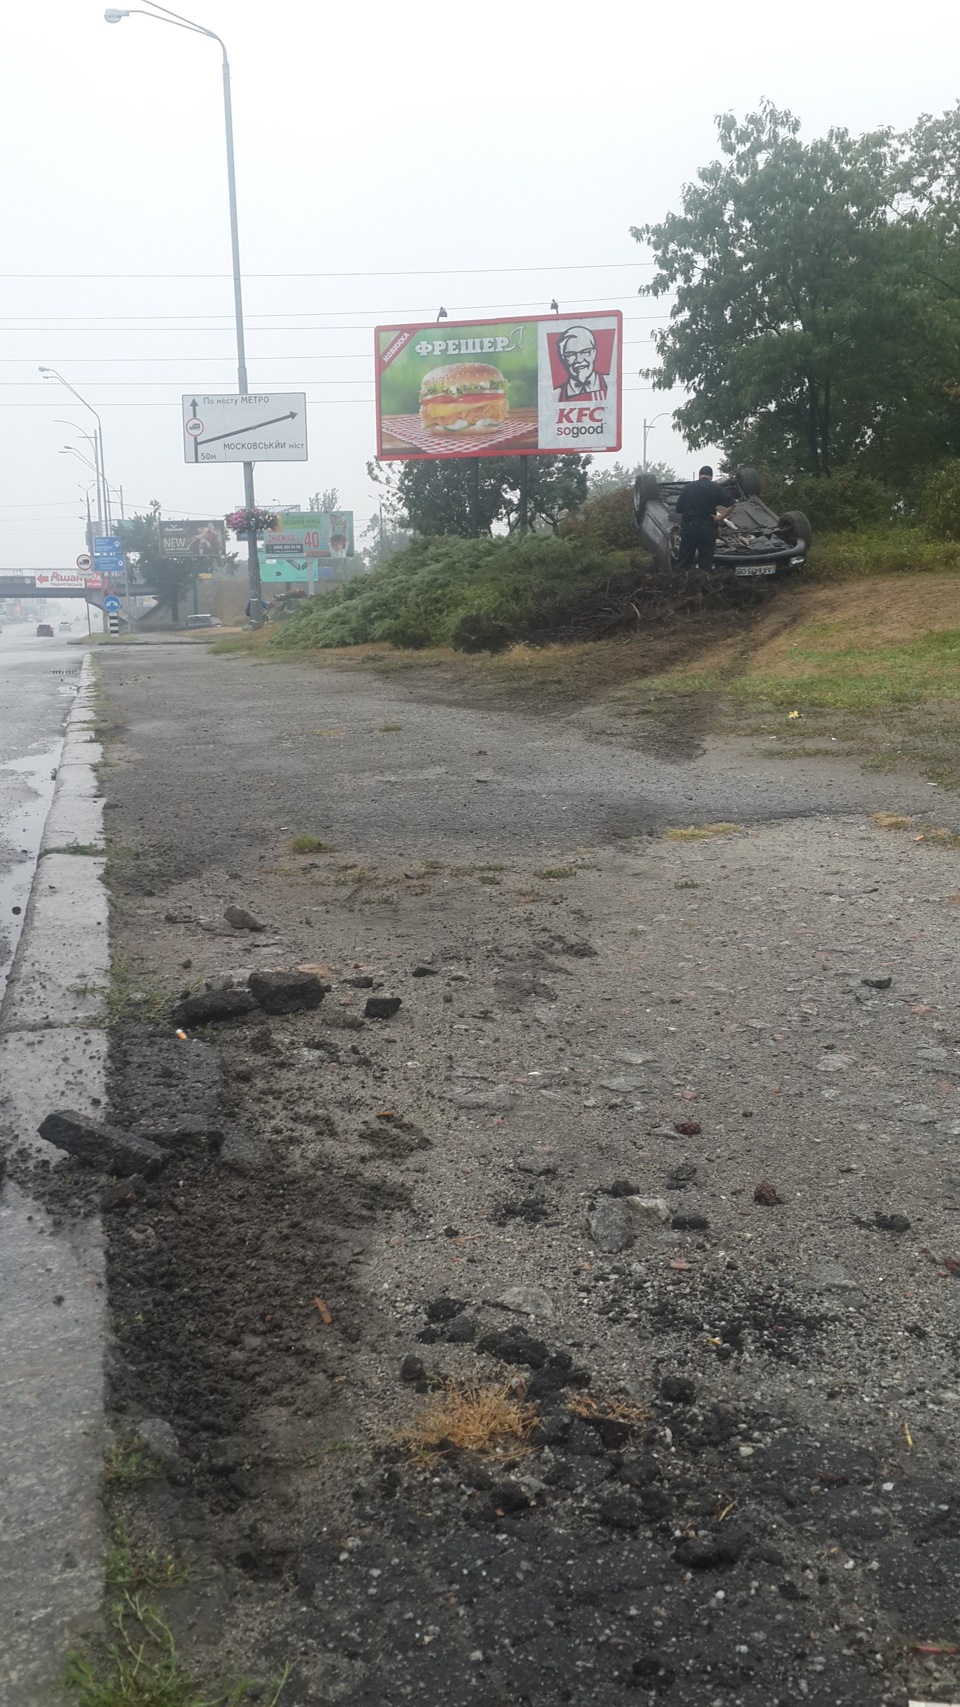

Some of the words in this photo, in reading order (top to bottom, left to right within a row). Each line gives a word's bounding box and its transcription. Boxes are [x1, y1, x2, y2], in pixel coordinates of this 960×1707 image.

[382, 332, 411, 363] НОВИНКА
[415, 336, 510, 357] ФРЕШЕР
[203, 396, 214, 405] По
[216, 397, 238, 406] мосту
[240, 395, 270, 404] МЕТРО
[556, 406, 605, 424] KFC
[288, 442, 304, 450] міст
[163, 538, 186, 548] NEW
[304, 531, 320, 548] 40
